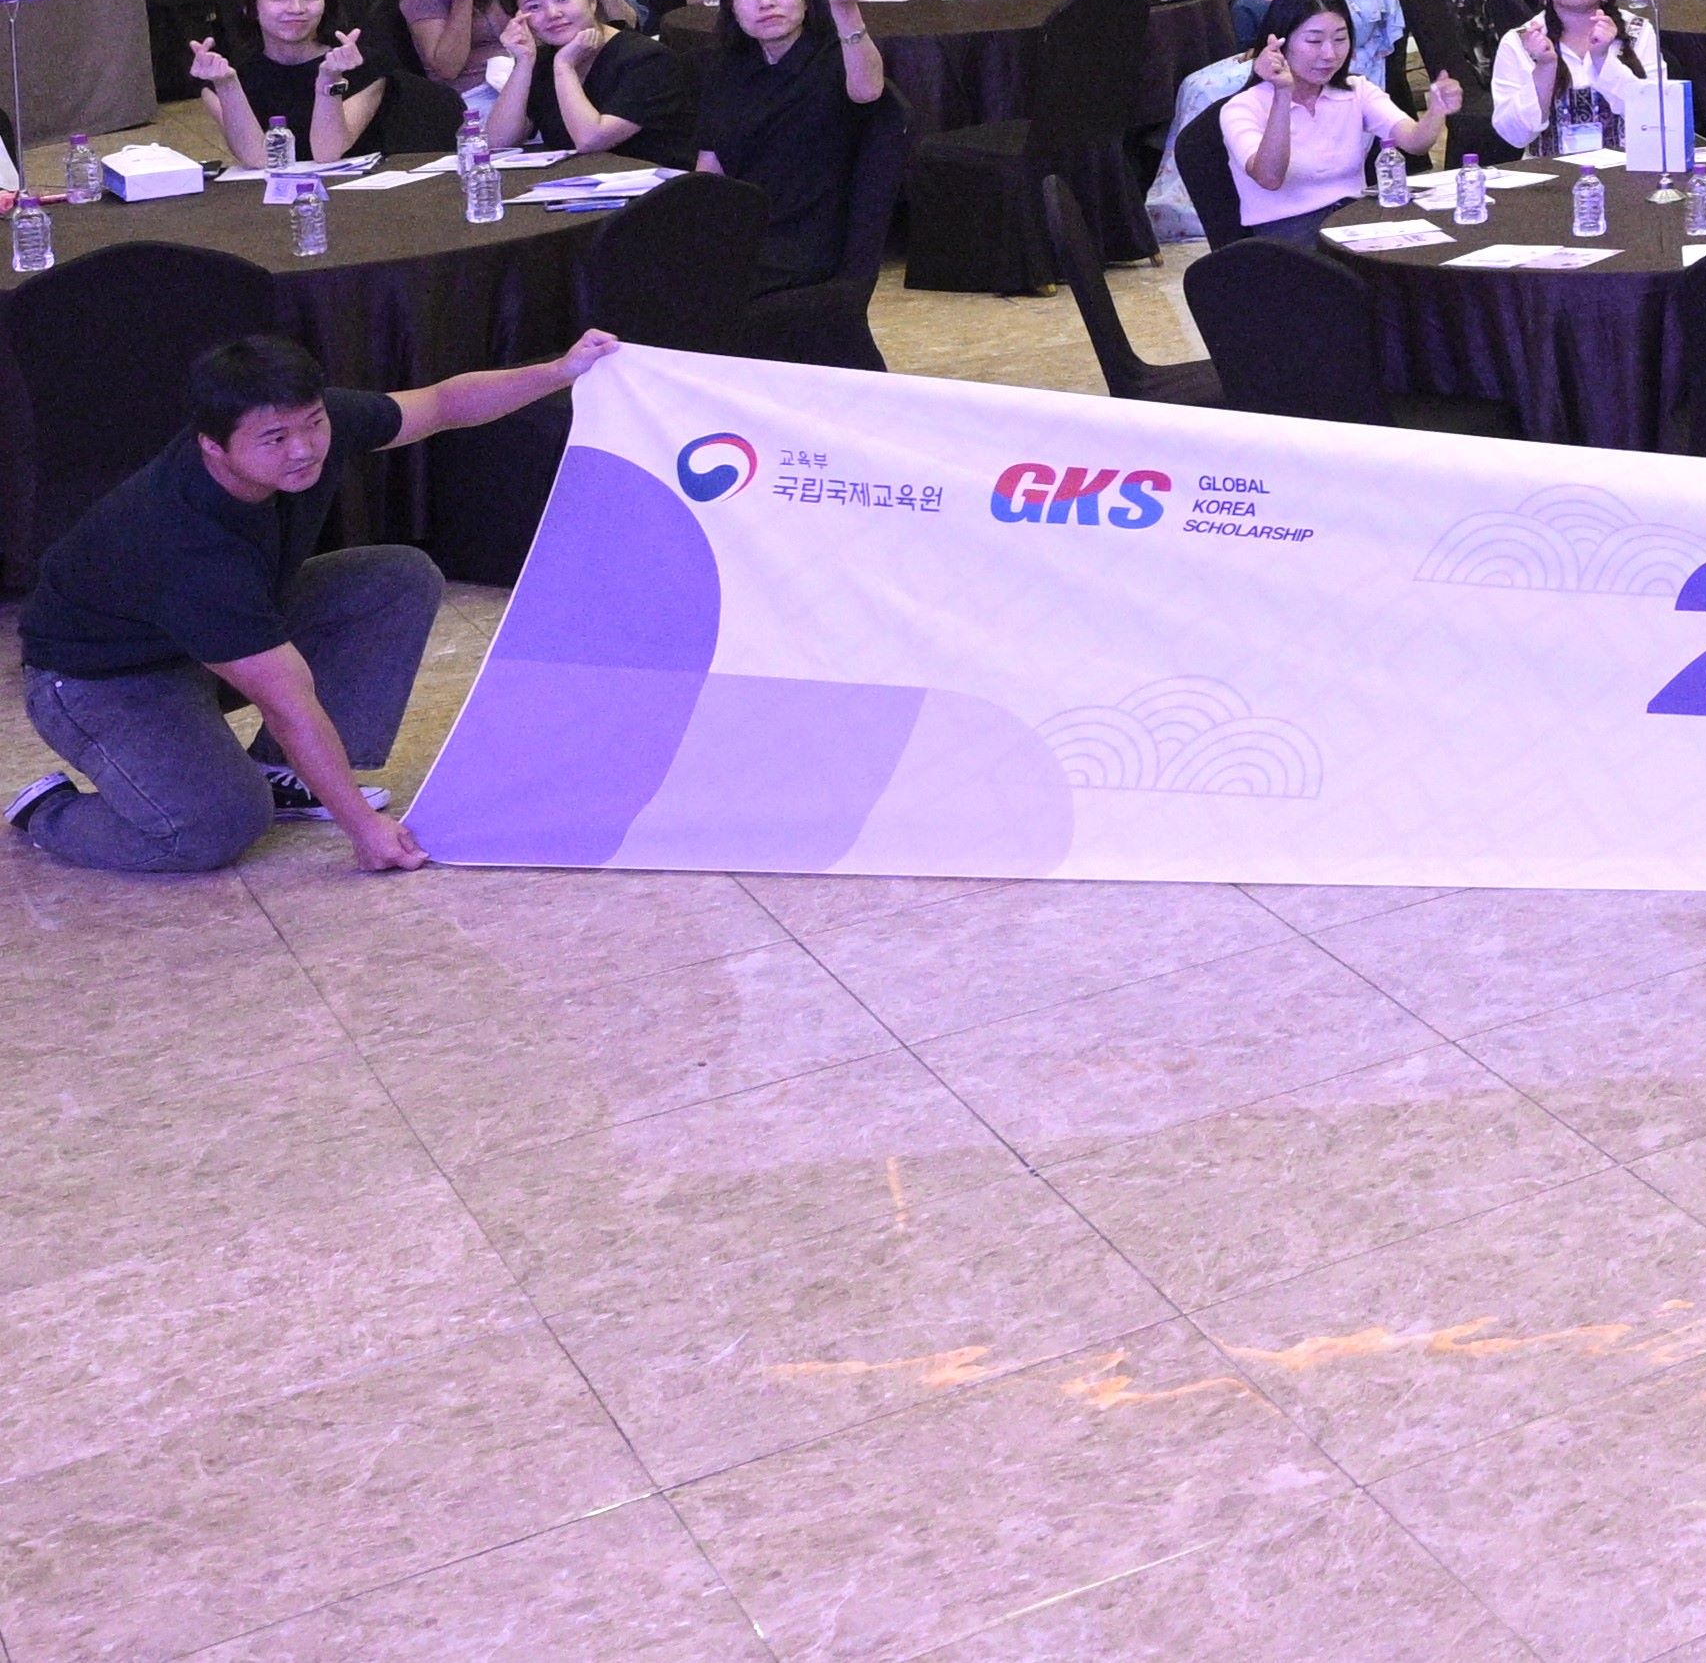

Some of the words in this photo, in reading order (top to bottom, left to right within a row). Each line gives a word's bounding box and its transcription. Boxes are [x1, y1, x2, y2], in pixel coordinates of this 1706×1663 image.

[781, 450, 827, 468] 교육부
[774, 476, 942, 512] 국립국제교육원
[1199, 476, 1269, 493] GLOBAL
[991, 463, 1171, 529] GKS
[1193, 500, 1255, 516] KOREA
[1184, 520, 1313, 541] SCHOLARSHIP
